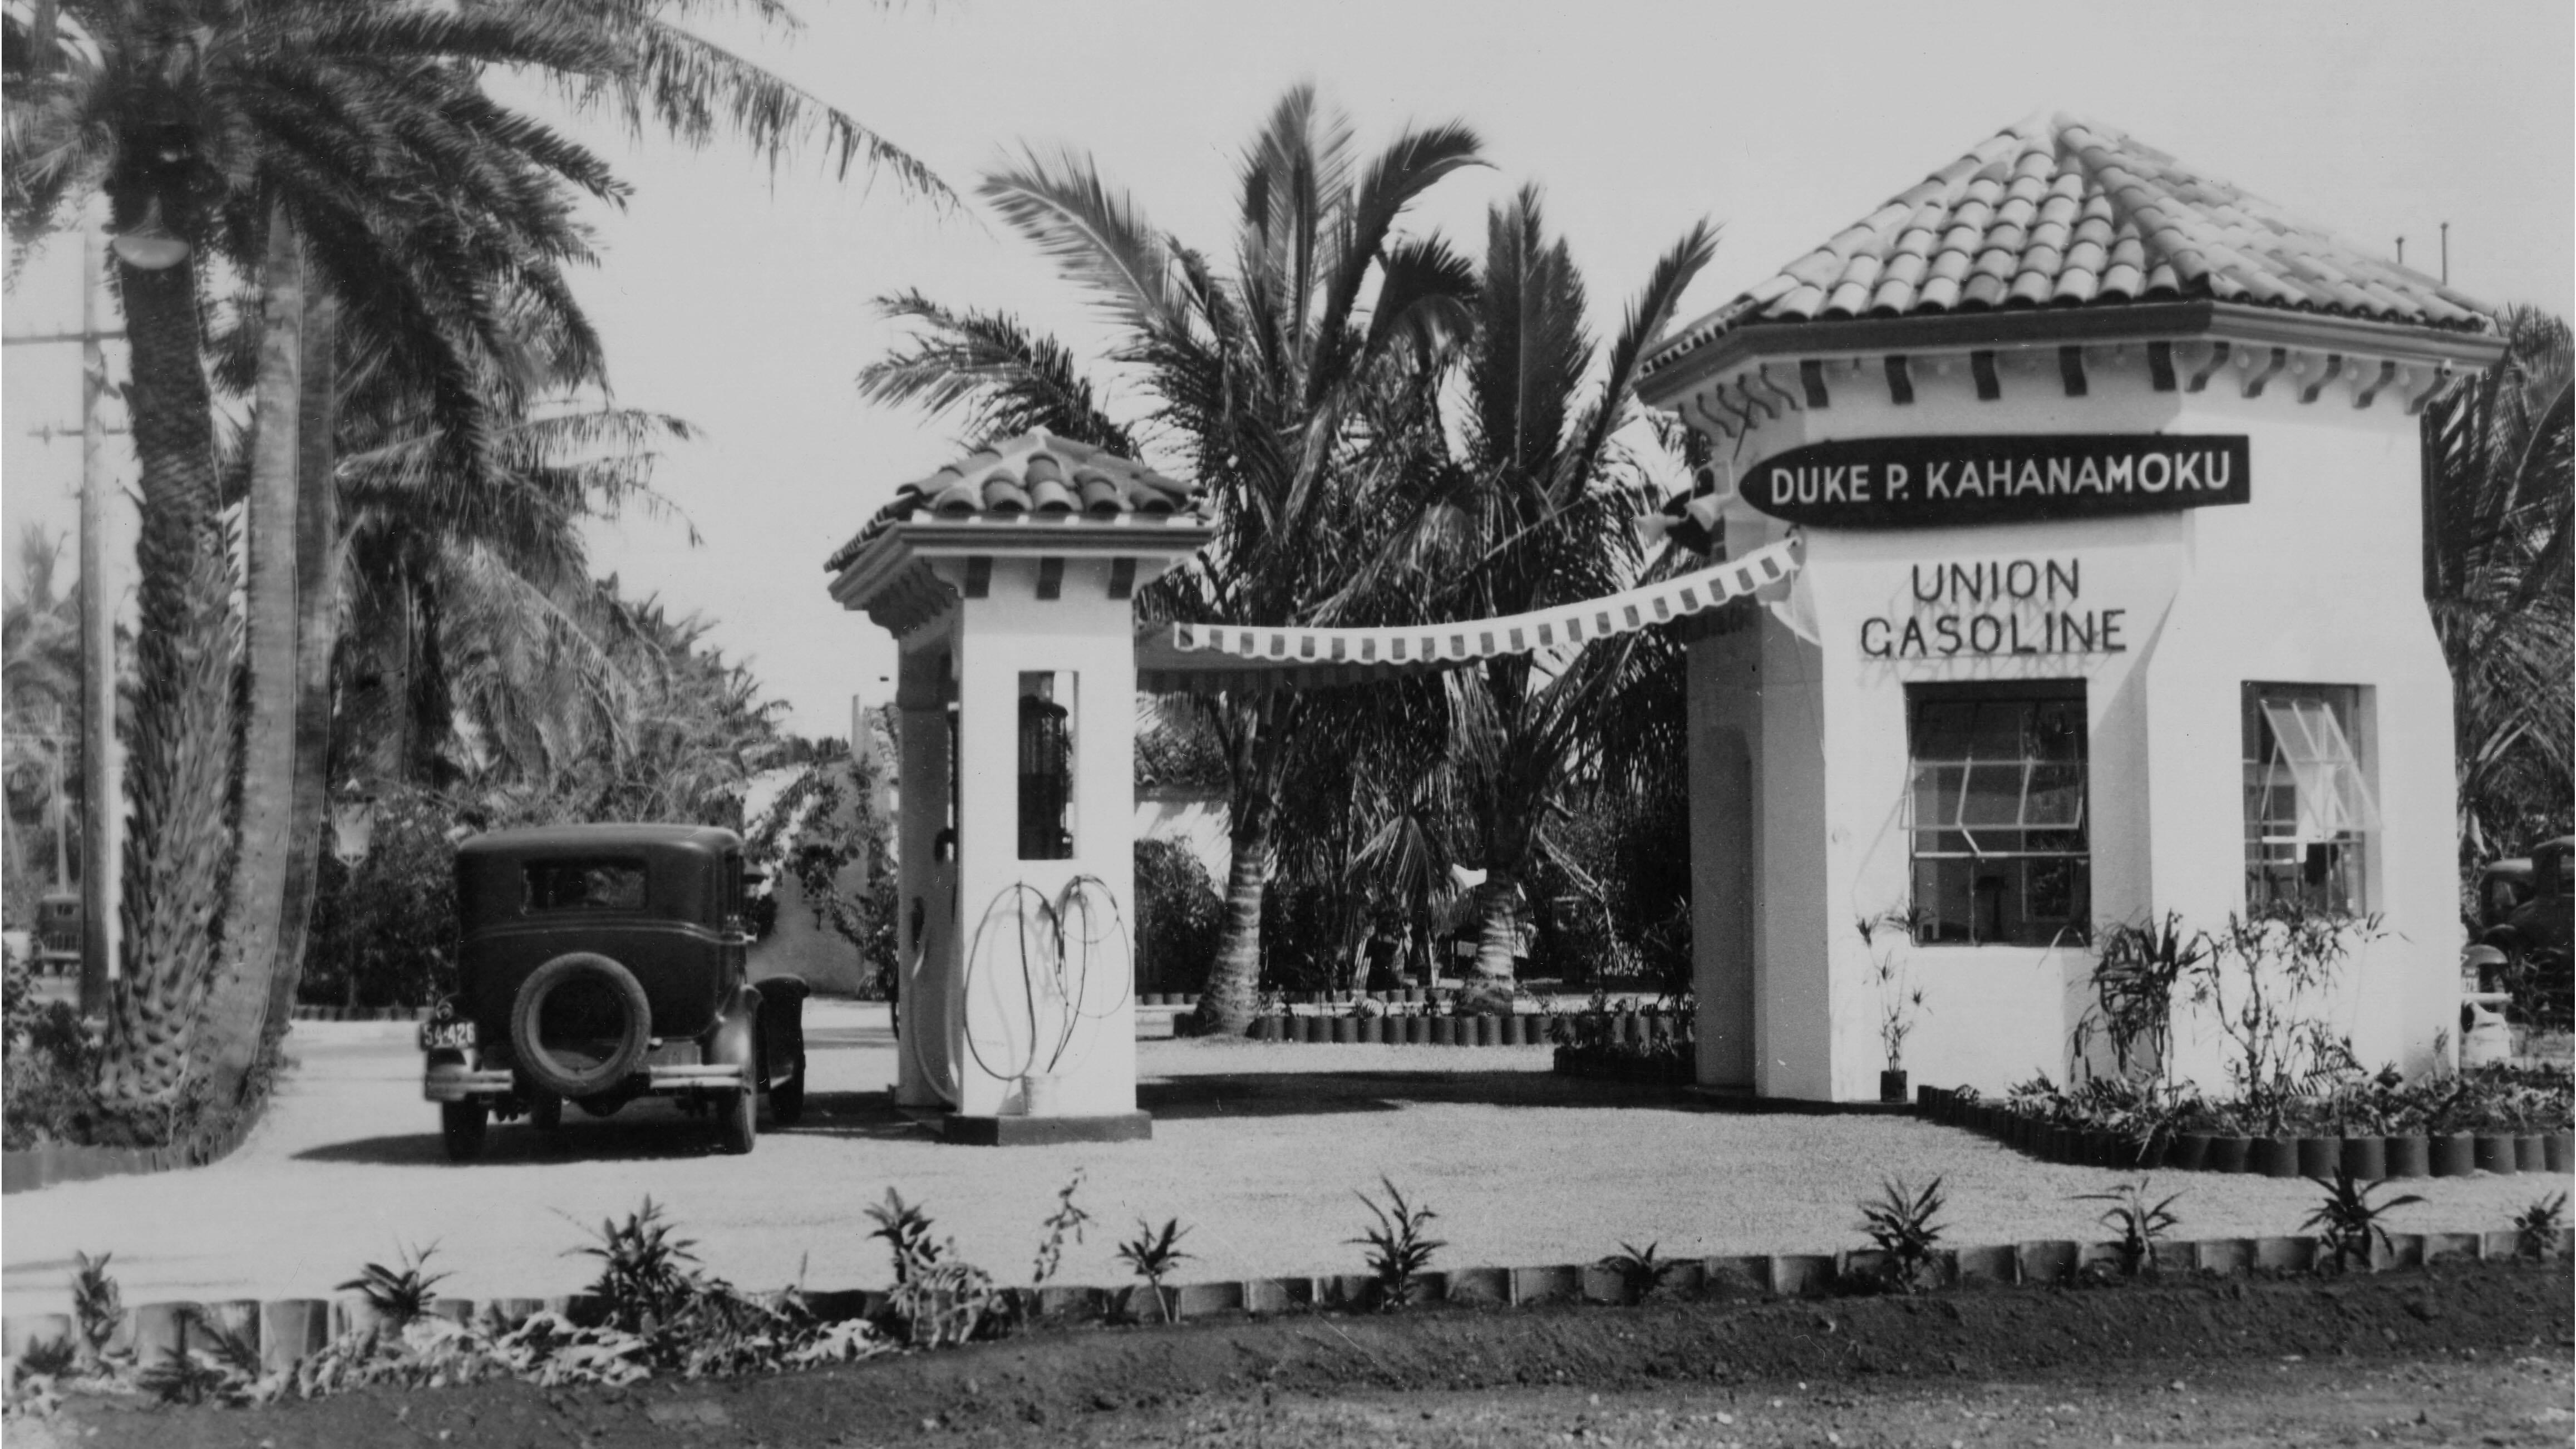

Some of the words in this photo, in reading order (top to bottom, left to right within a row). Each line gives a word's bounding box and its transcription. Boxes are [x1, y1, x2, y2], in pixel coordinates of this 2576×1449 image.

[1771, 465, 1870, 504] DUKE
[1885, 464, 1910, 500] P.
[1925, 451, 2230, 499] KAHANAMOKU
[1912, 558, 2079, 603] UNION
[1861, 609, 2126, 657] GASOLINE
